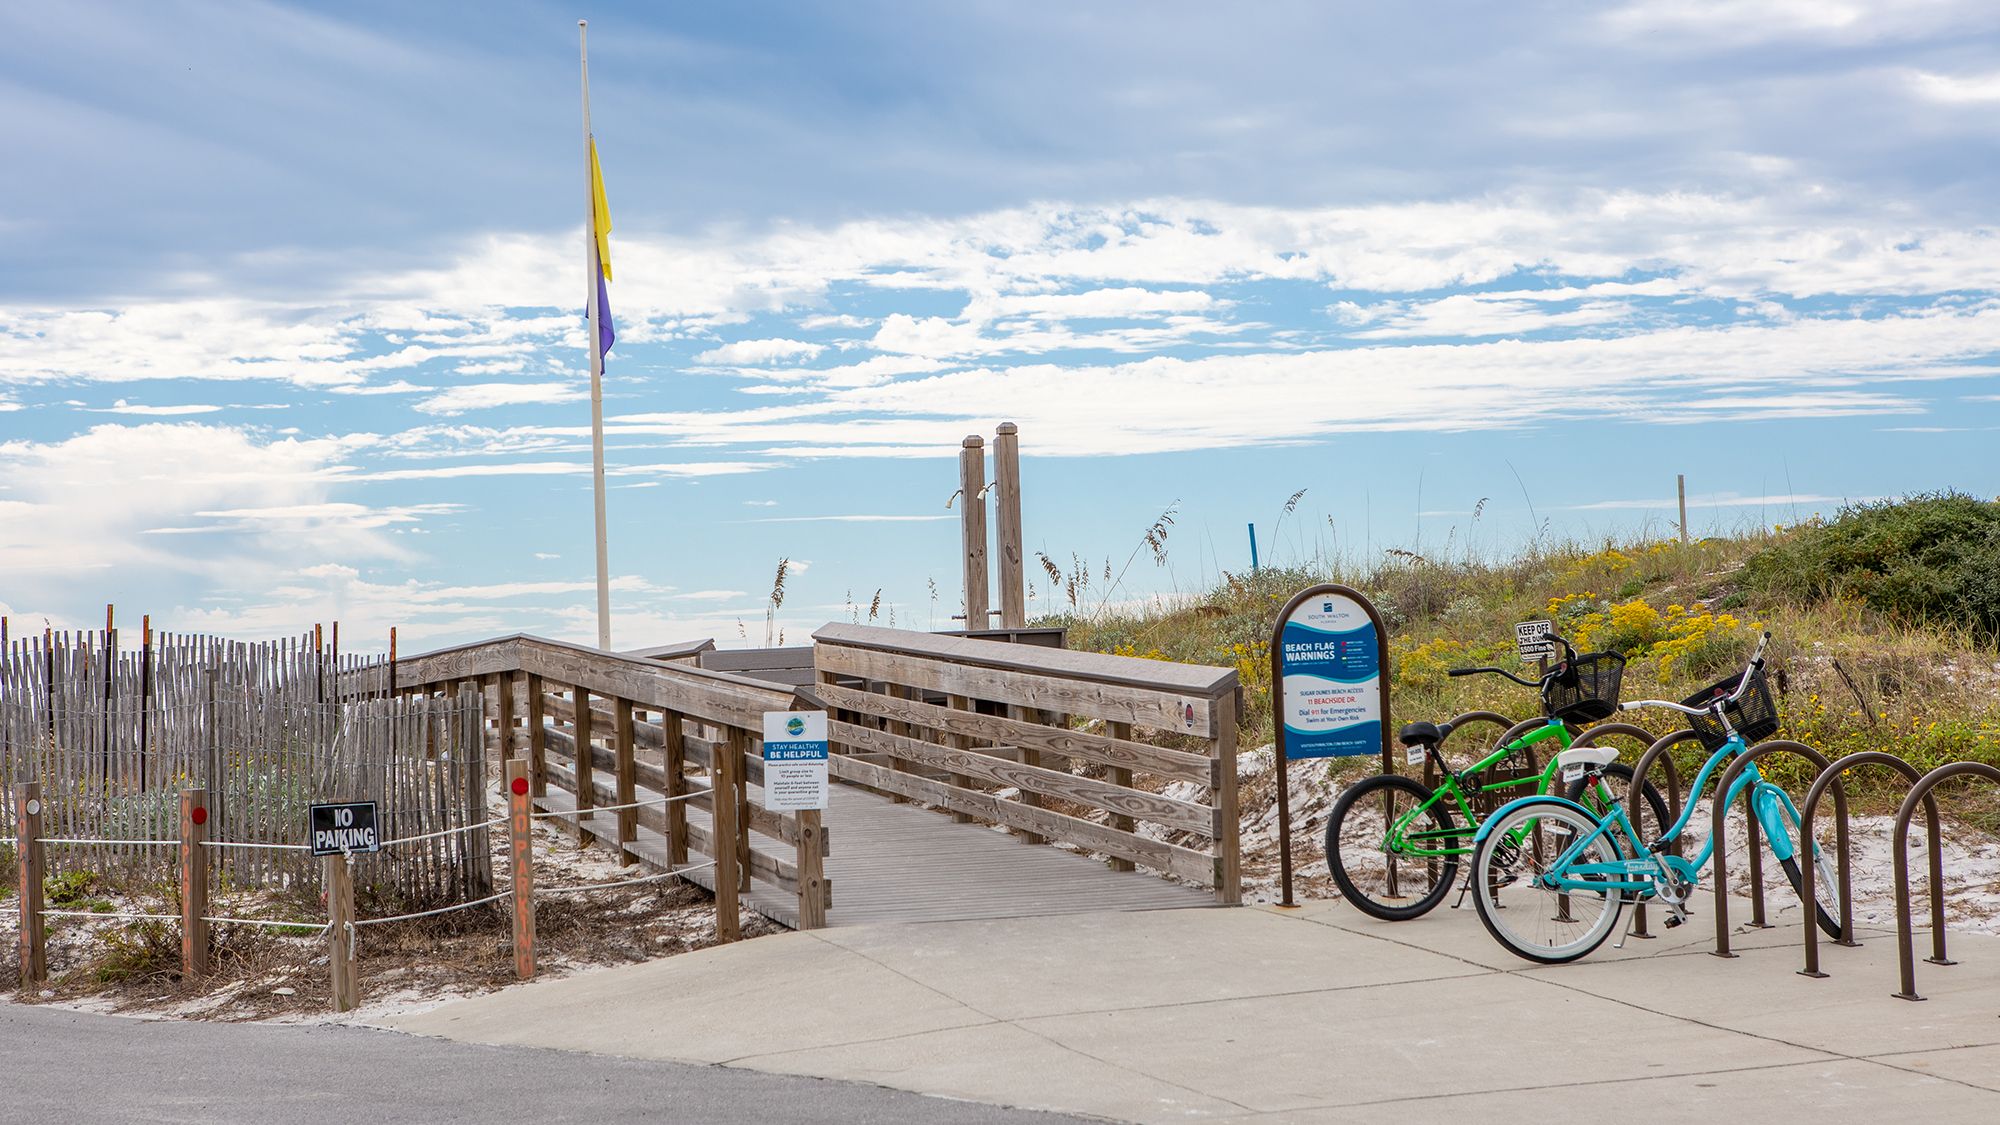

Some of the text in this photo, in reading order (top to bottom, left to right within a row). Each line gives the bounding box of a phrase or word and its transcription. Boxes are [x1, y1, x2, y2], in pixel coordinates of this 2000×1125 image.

[1518, 624, 1549, 636] KEEP OFF
[1286, 642, 1334, 652] BEACH FLAG
[1520, 645, 1534, 654] $500
[1286, 651, 1335, 661] WARNINGS
[334, 808, 353, 827] NO
[315, 826, 375, 849] PARKING
[1624, 860, 1660, 874] Tuesday
